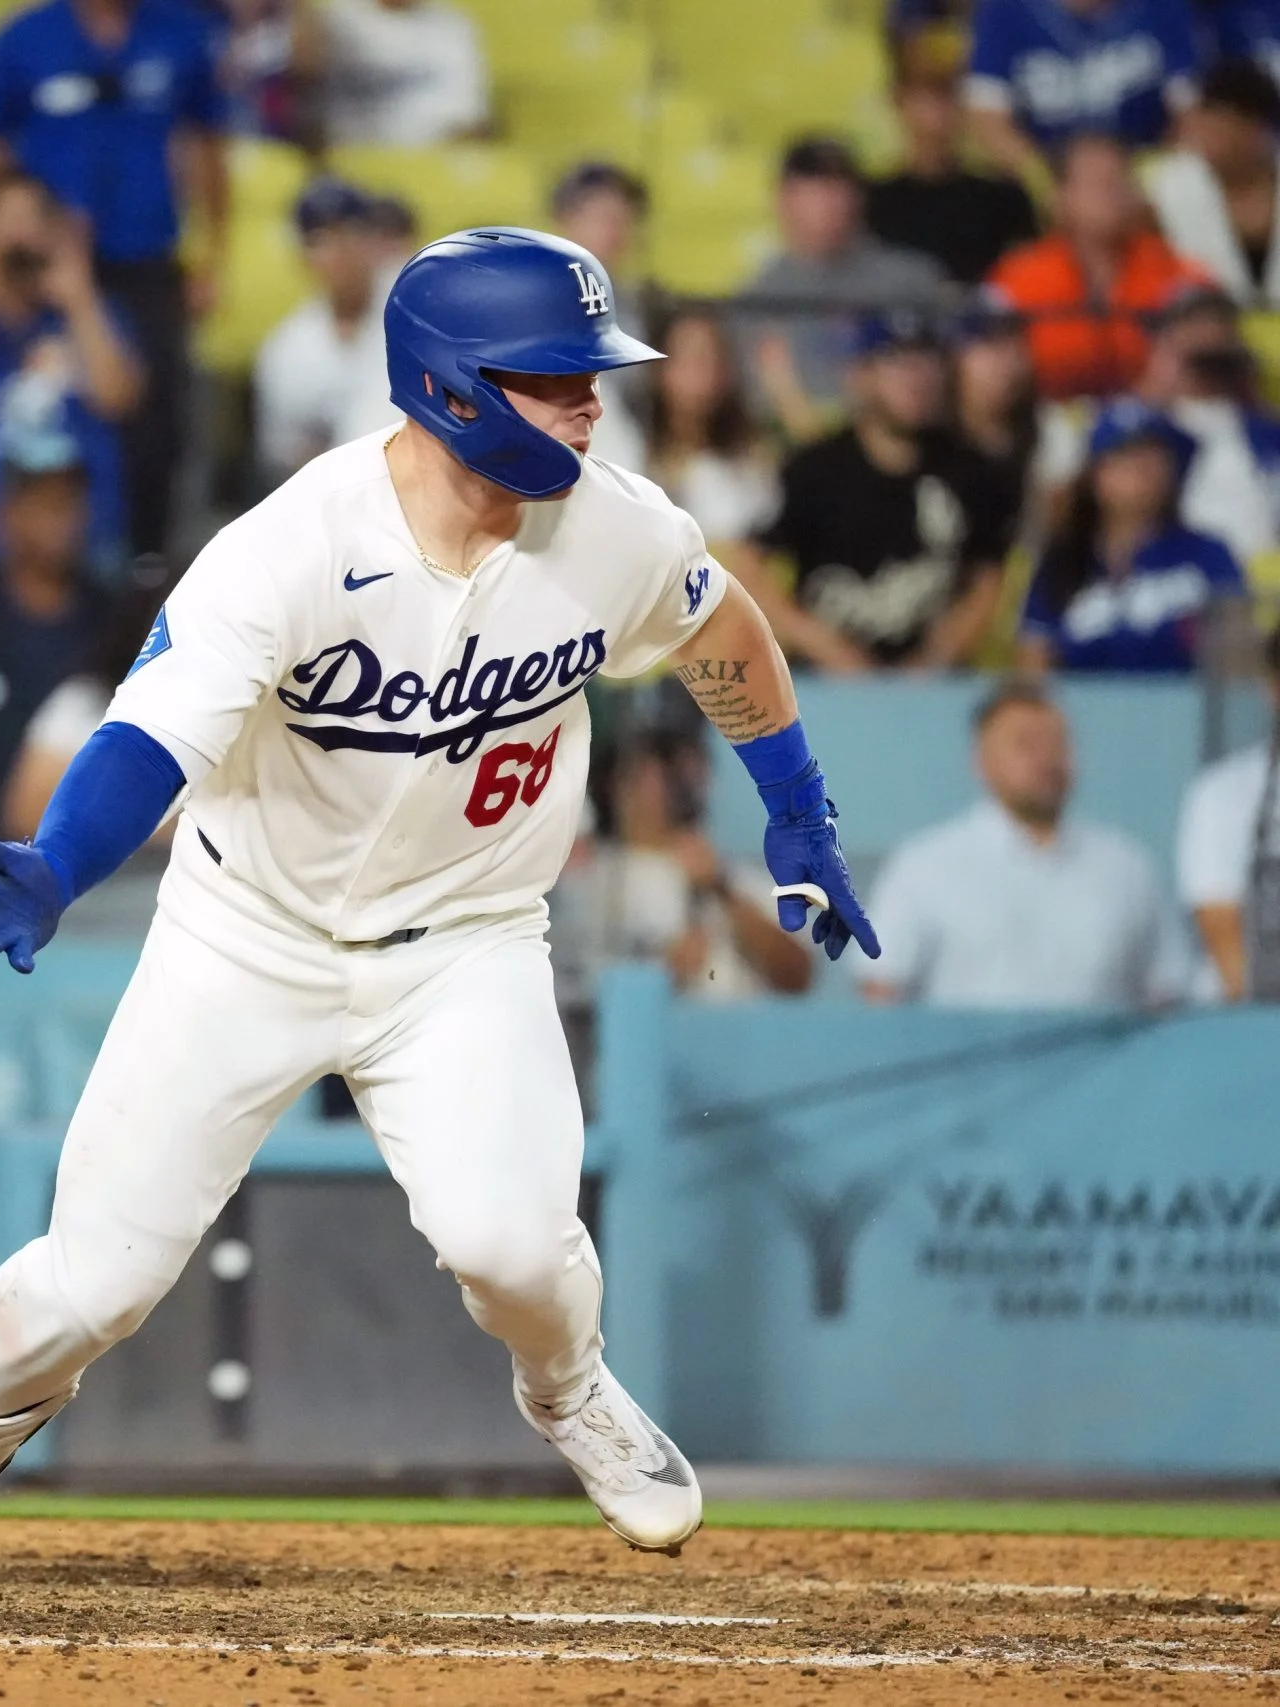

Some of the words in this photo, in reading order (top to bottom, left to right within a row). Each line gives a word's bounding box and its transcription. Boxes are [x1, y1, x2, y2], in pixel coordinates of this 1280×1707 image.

[568, 262, 608, 316] LA
[277, 628, 607, 764] Dodgers
[464, 723, 561, 828] 68
